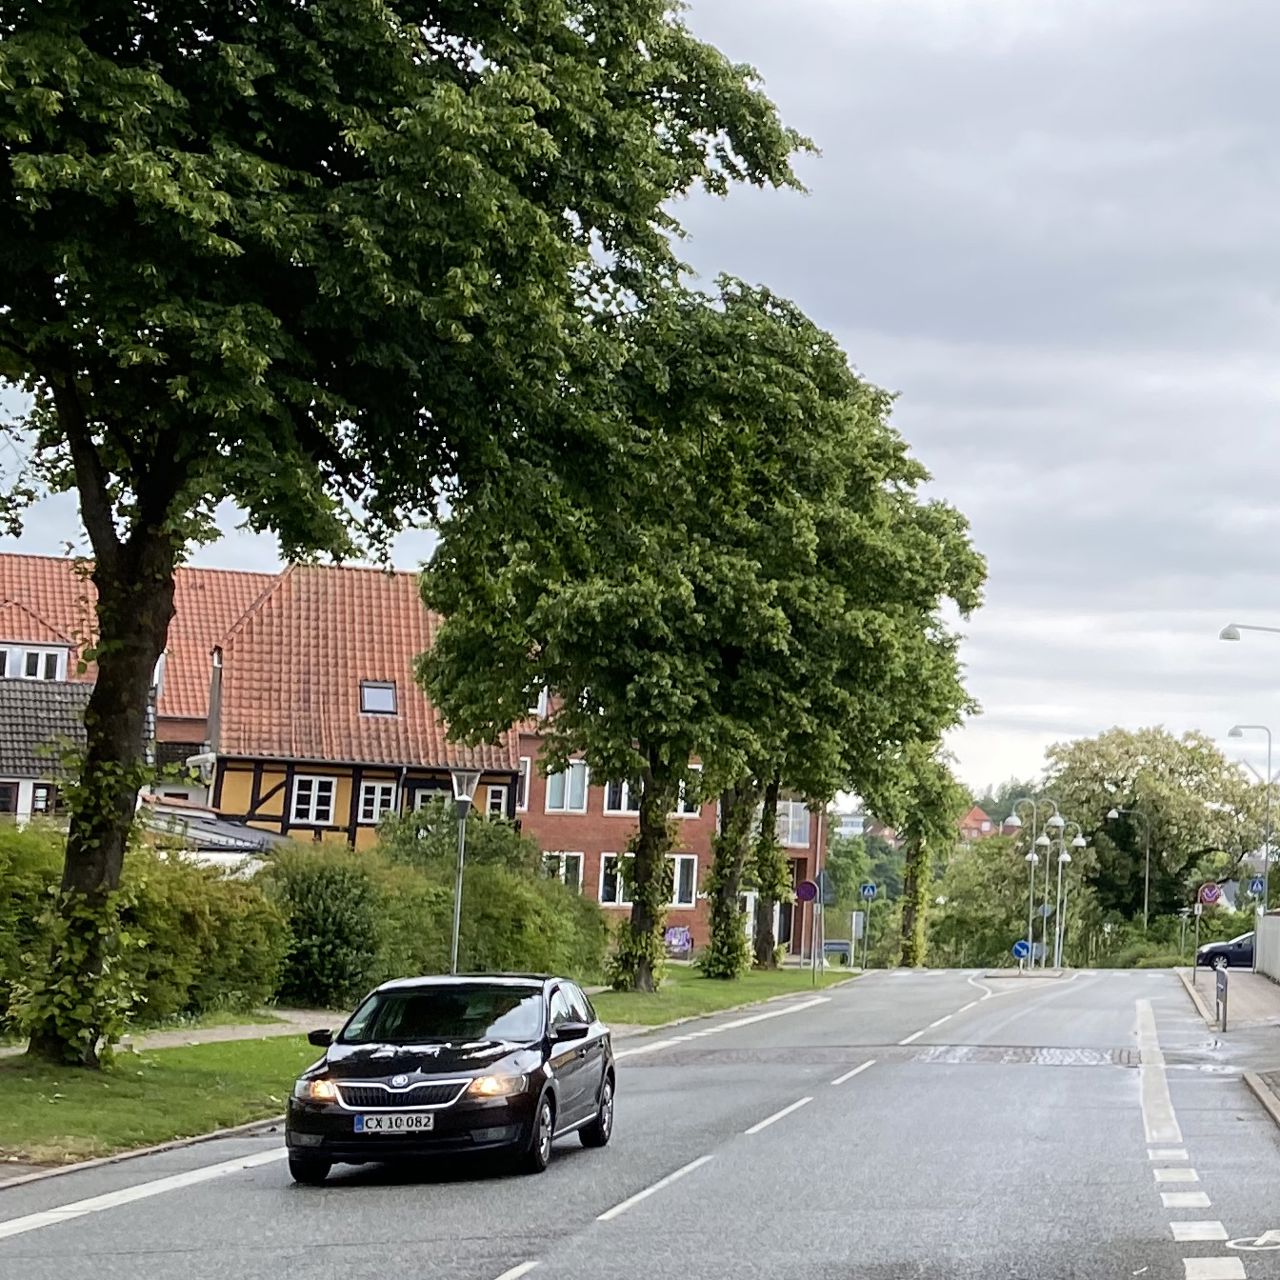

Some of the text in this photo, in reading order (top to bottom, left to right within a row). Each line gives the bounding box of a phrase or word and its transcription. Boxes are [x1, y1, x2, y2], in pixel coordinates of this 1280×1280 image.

[365, 1116, 431, 1129] CX 10 082
